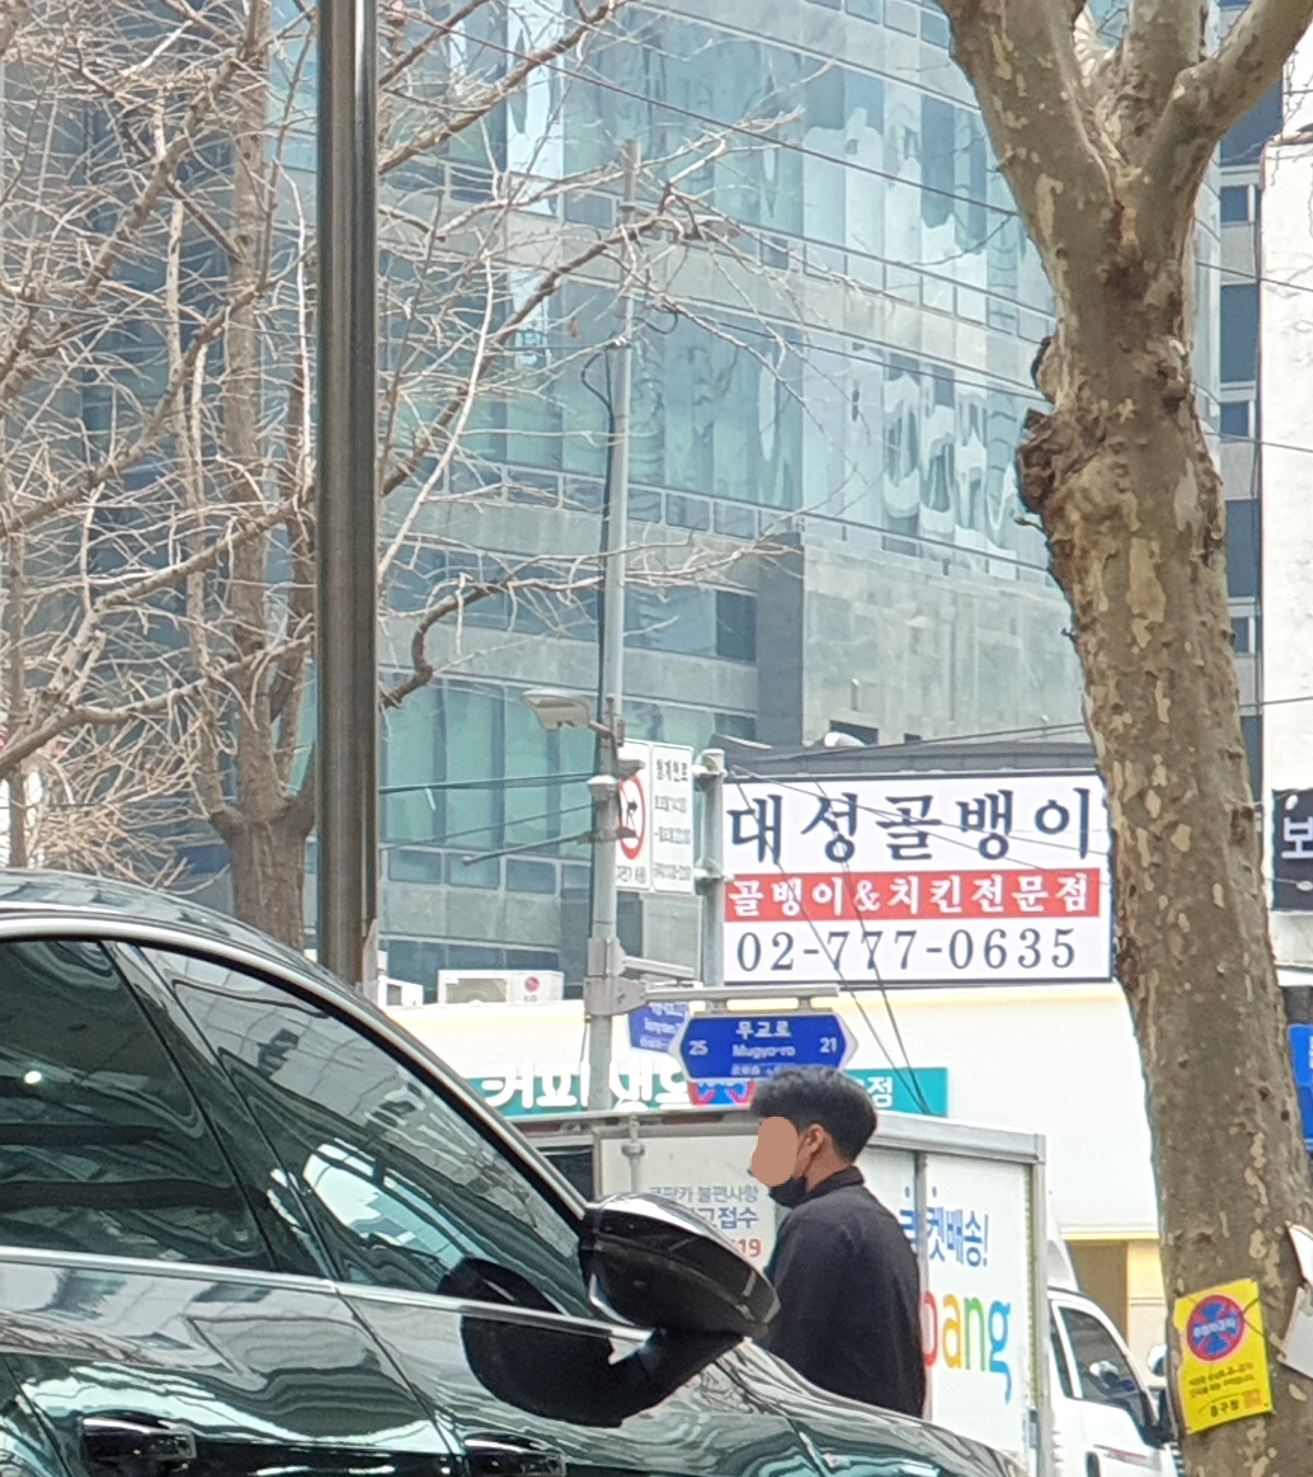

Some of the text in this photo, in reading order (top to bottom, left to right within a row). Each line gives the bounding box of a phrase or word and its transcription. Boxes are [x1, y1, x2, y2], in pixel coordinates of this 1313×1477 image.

[726, 788, 1090, 864] 대성골뱅이
[728, 874, 1088, 916] 골뱅이&치킨전문점
[738, 928, 1075, 971] 02-777-0635
[689, 1041, 708, 1056] 25
[821, 1038, 837, 1053] 21
[480, 1058, 590, 1109] 커피
[734, 1238, 762, 1258] 19
